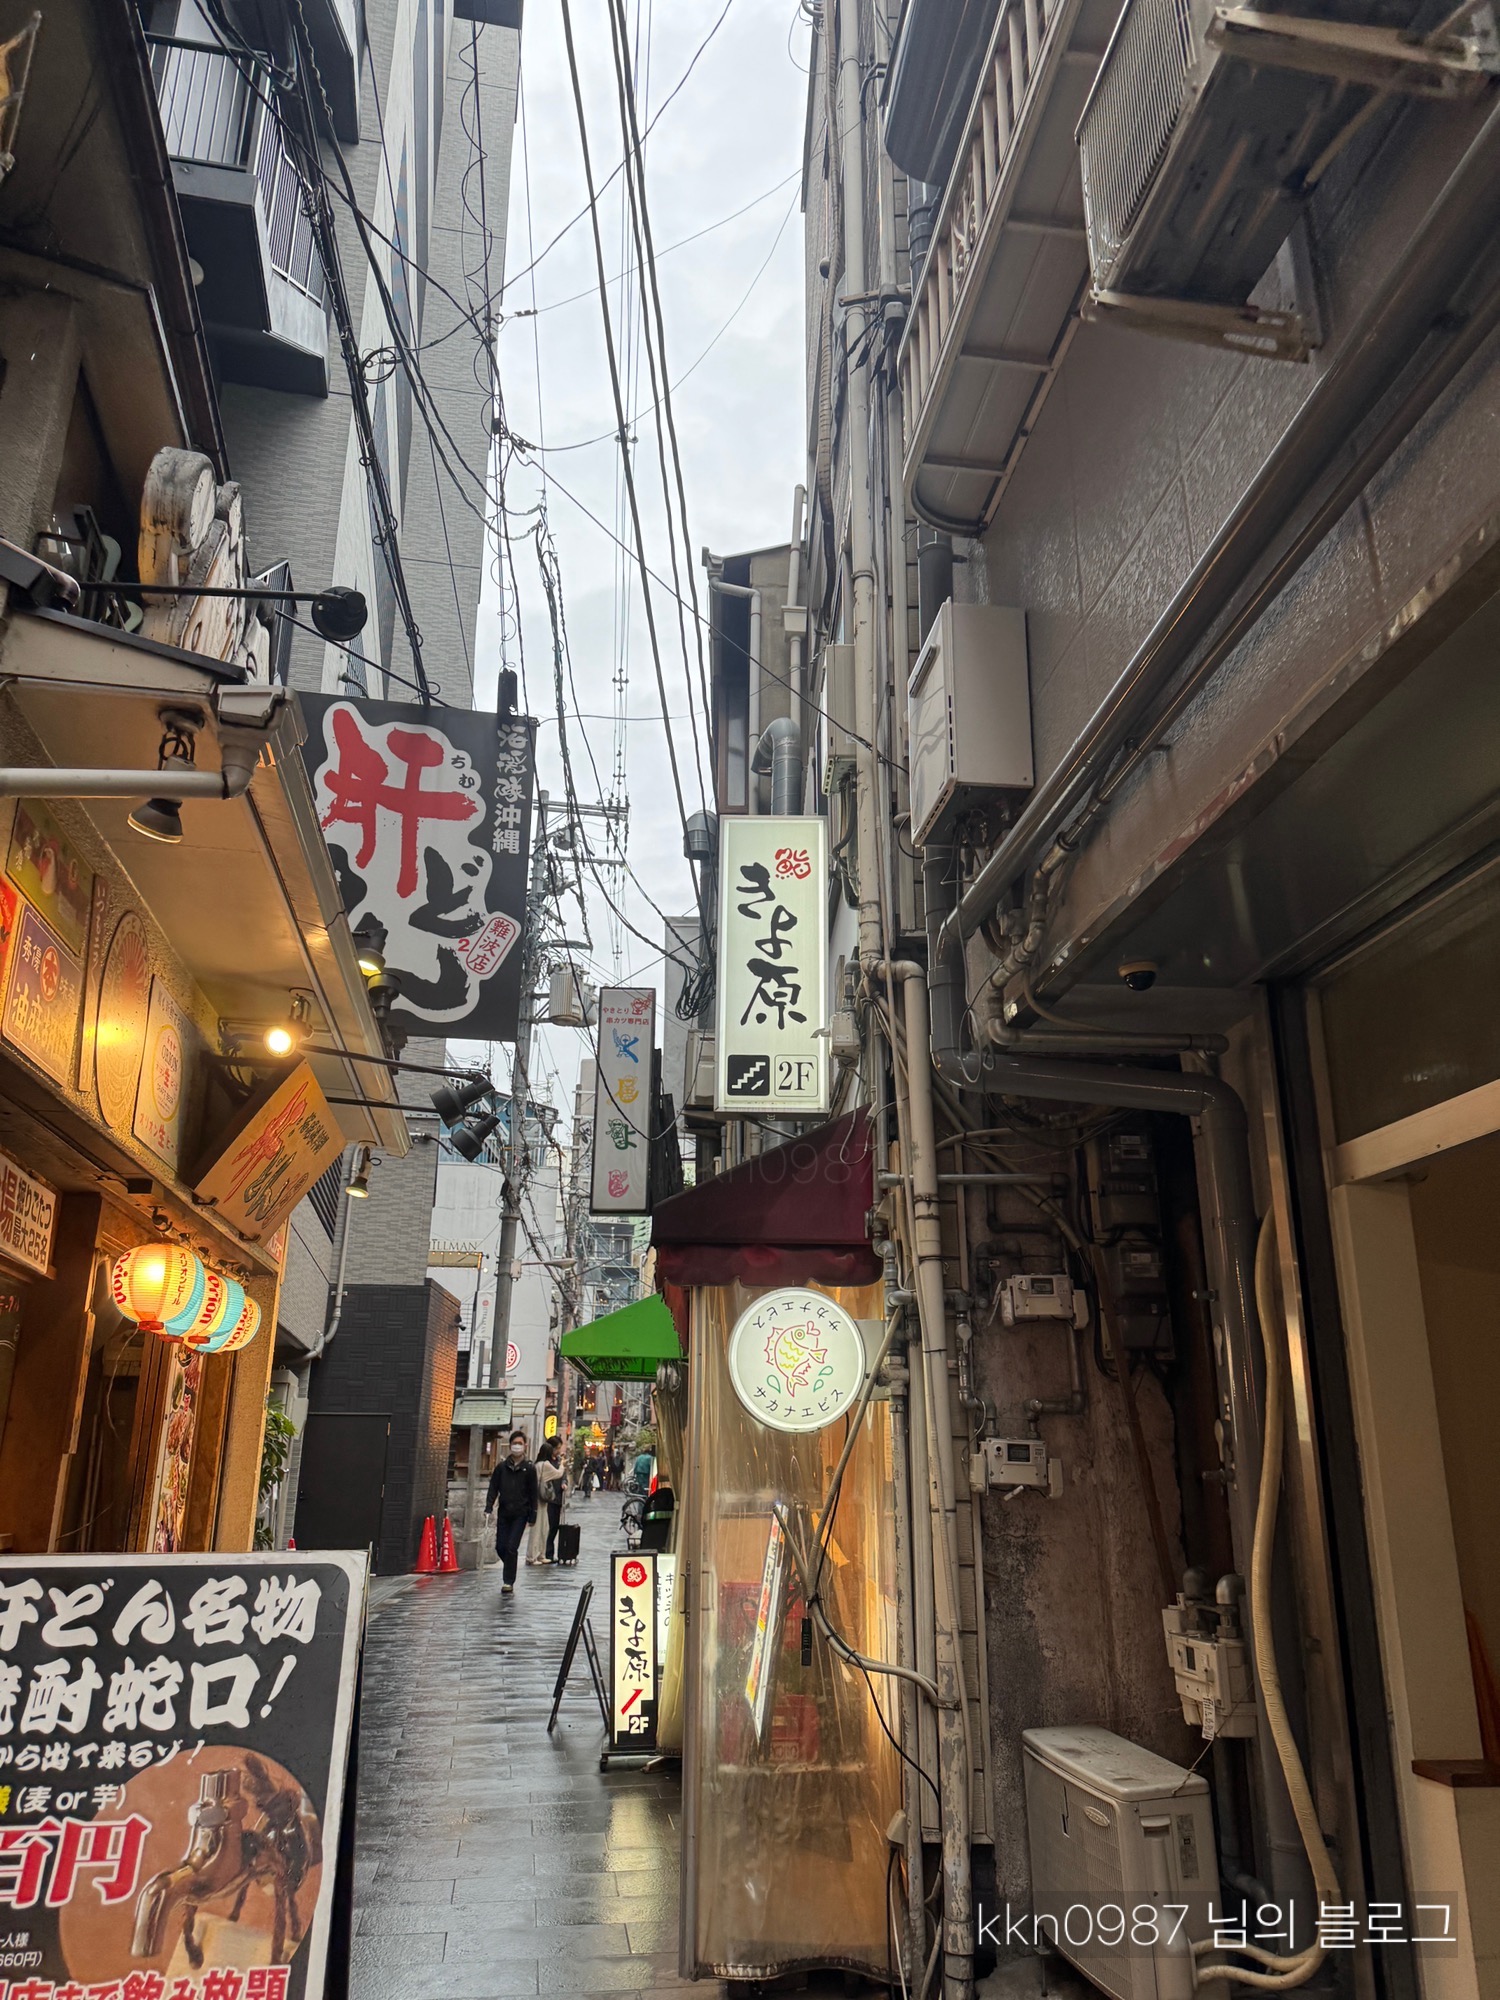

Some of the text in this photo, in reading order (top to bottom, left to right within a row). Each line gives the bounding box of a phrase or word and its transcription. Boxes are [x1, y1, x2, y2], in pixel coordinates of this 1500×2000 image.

[450, 754, 477, 789] ちむ
[457, 938, 470, 953] 2
[470, 917, 512, 973] 難波店
[736, 862, 807, 1029] きよ原
[606, 1017, 649, 1025] 串カツ専門店
[778, 1061, 815, 1091] 2F
[12, 1216, 49, 1267] 最大25名
[172, 1252, 187, 1306] オリオンビール
[754, 1386, 843, 1417] サカナエビス
[619, 1596, 650, 1682] きよ原
[0, 1654, 297, 1735] 酎蛇口!
[630, 1716, 649, 1733] 2F
[16, 1786, 52, 1814] (麦
[56, 1791, 88, 1810] or
[92, 1784, 126, 1811] 芋)
